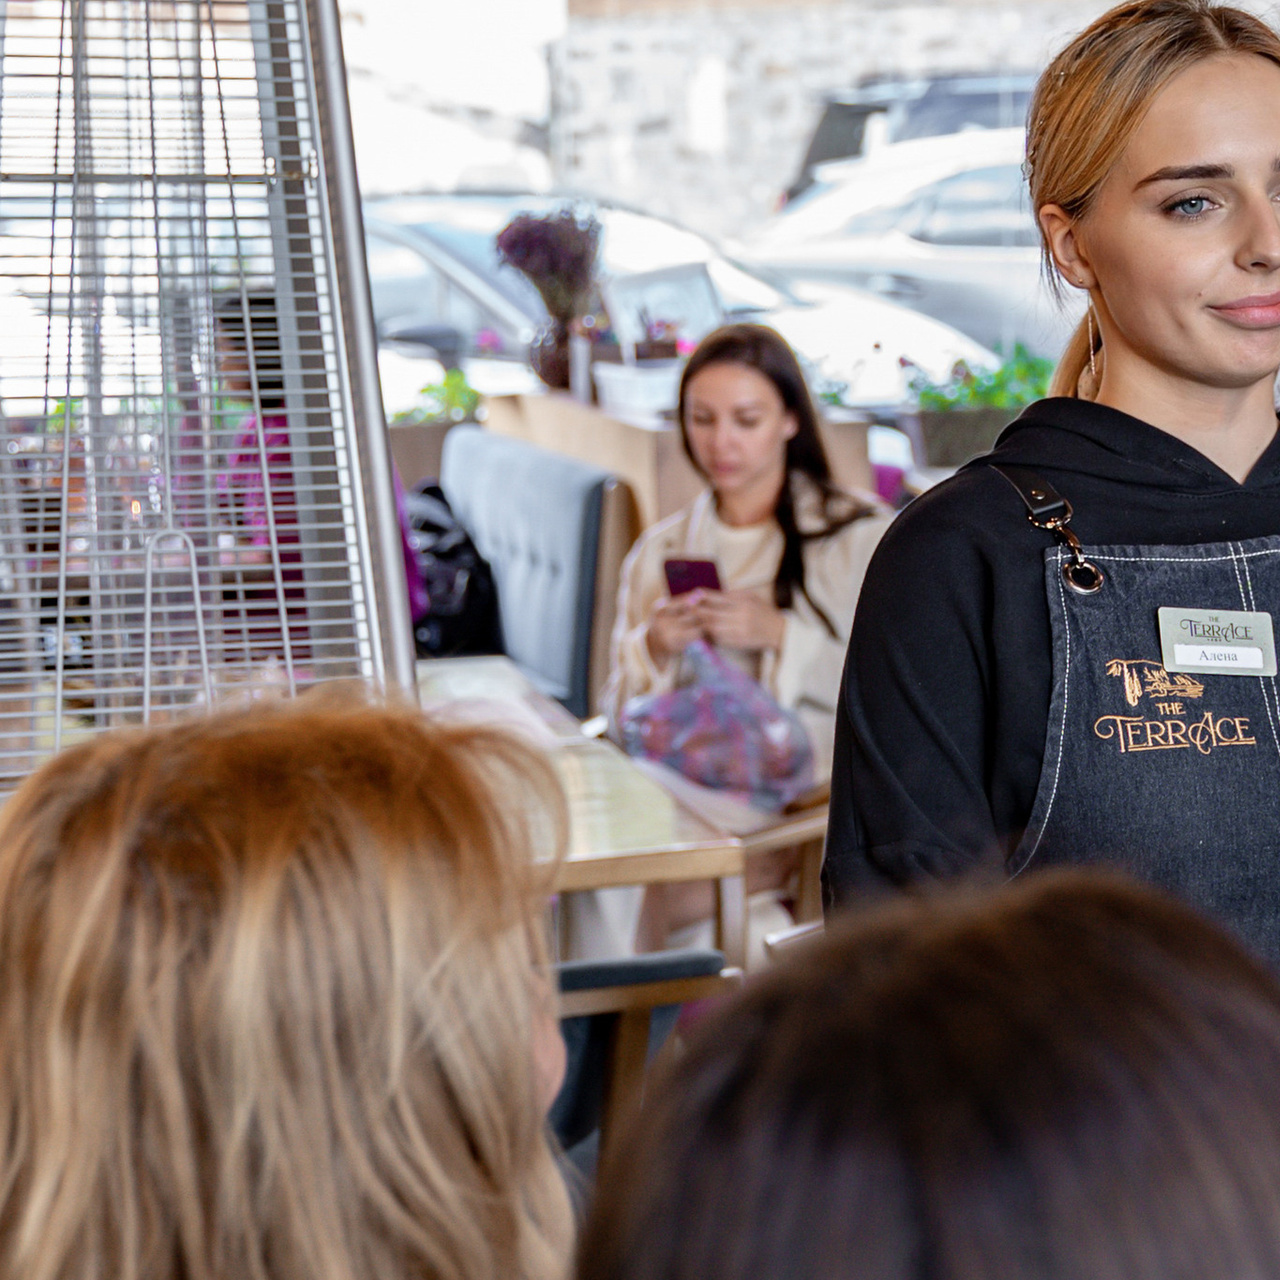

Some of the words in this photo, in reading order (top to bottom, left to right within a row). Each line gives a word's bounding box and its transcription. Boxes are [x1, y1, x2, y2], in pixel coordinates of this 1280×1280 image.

[1179, 619, 1254, 642] TERRACE
[1199, 650, 1238, 662] Алена
[1155, 702, 1187, 715] THE
[1093, 711, 1257, 755] TERRACE
